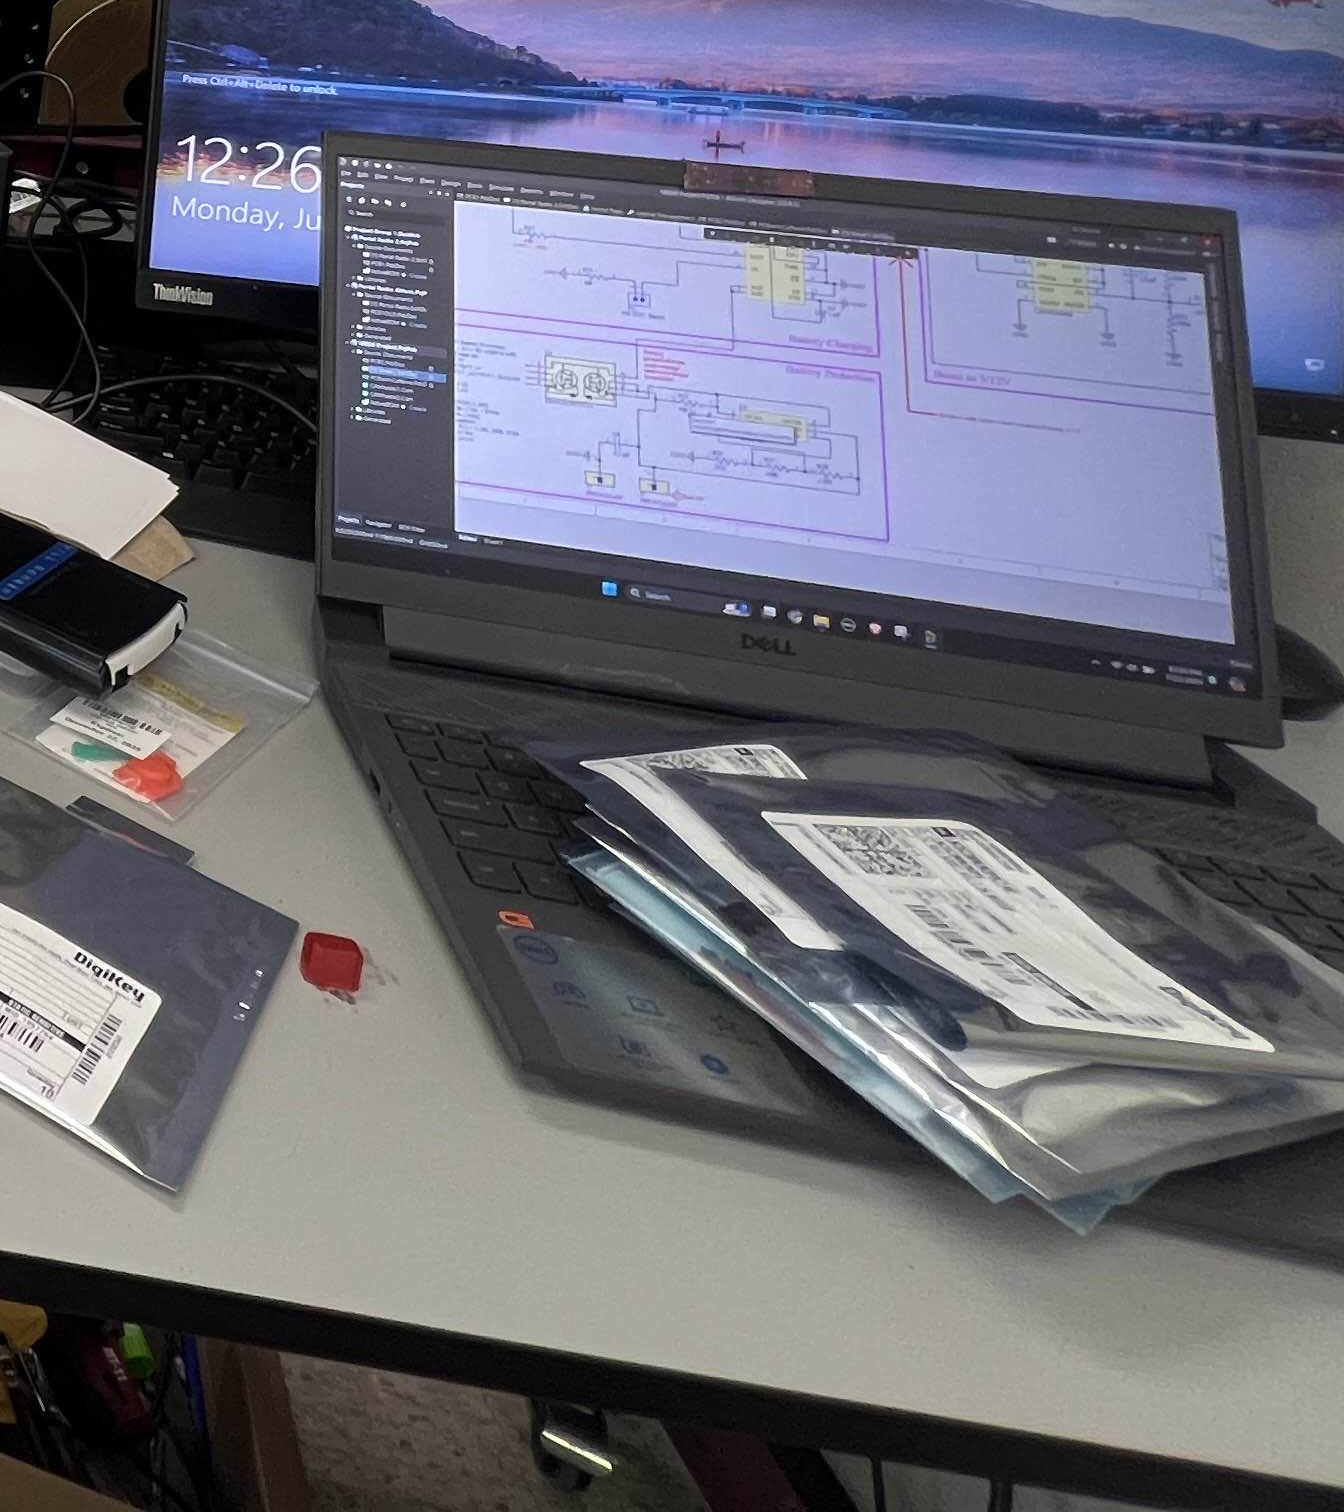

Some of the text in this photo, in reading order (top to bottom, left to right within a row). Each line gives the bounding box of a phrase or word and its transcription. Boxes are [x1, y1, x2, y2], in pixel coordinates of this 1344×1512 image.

[183, 74, 207, 85] Press
[177, 134, 322, 194] 12:26
[171, 196, 322, 232] Monday, Ju
[153, 283, 214, 306] ThinkVision
[740, 633, 797, 656] DELL
[71, 950, 148, 1004] DigiKey
